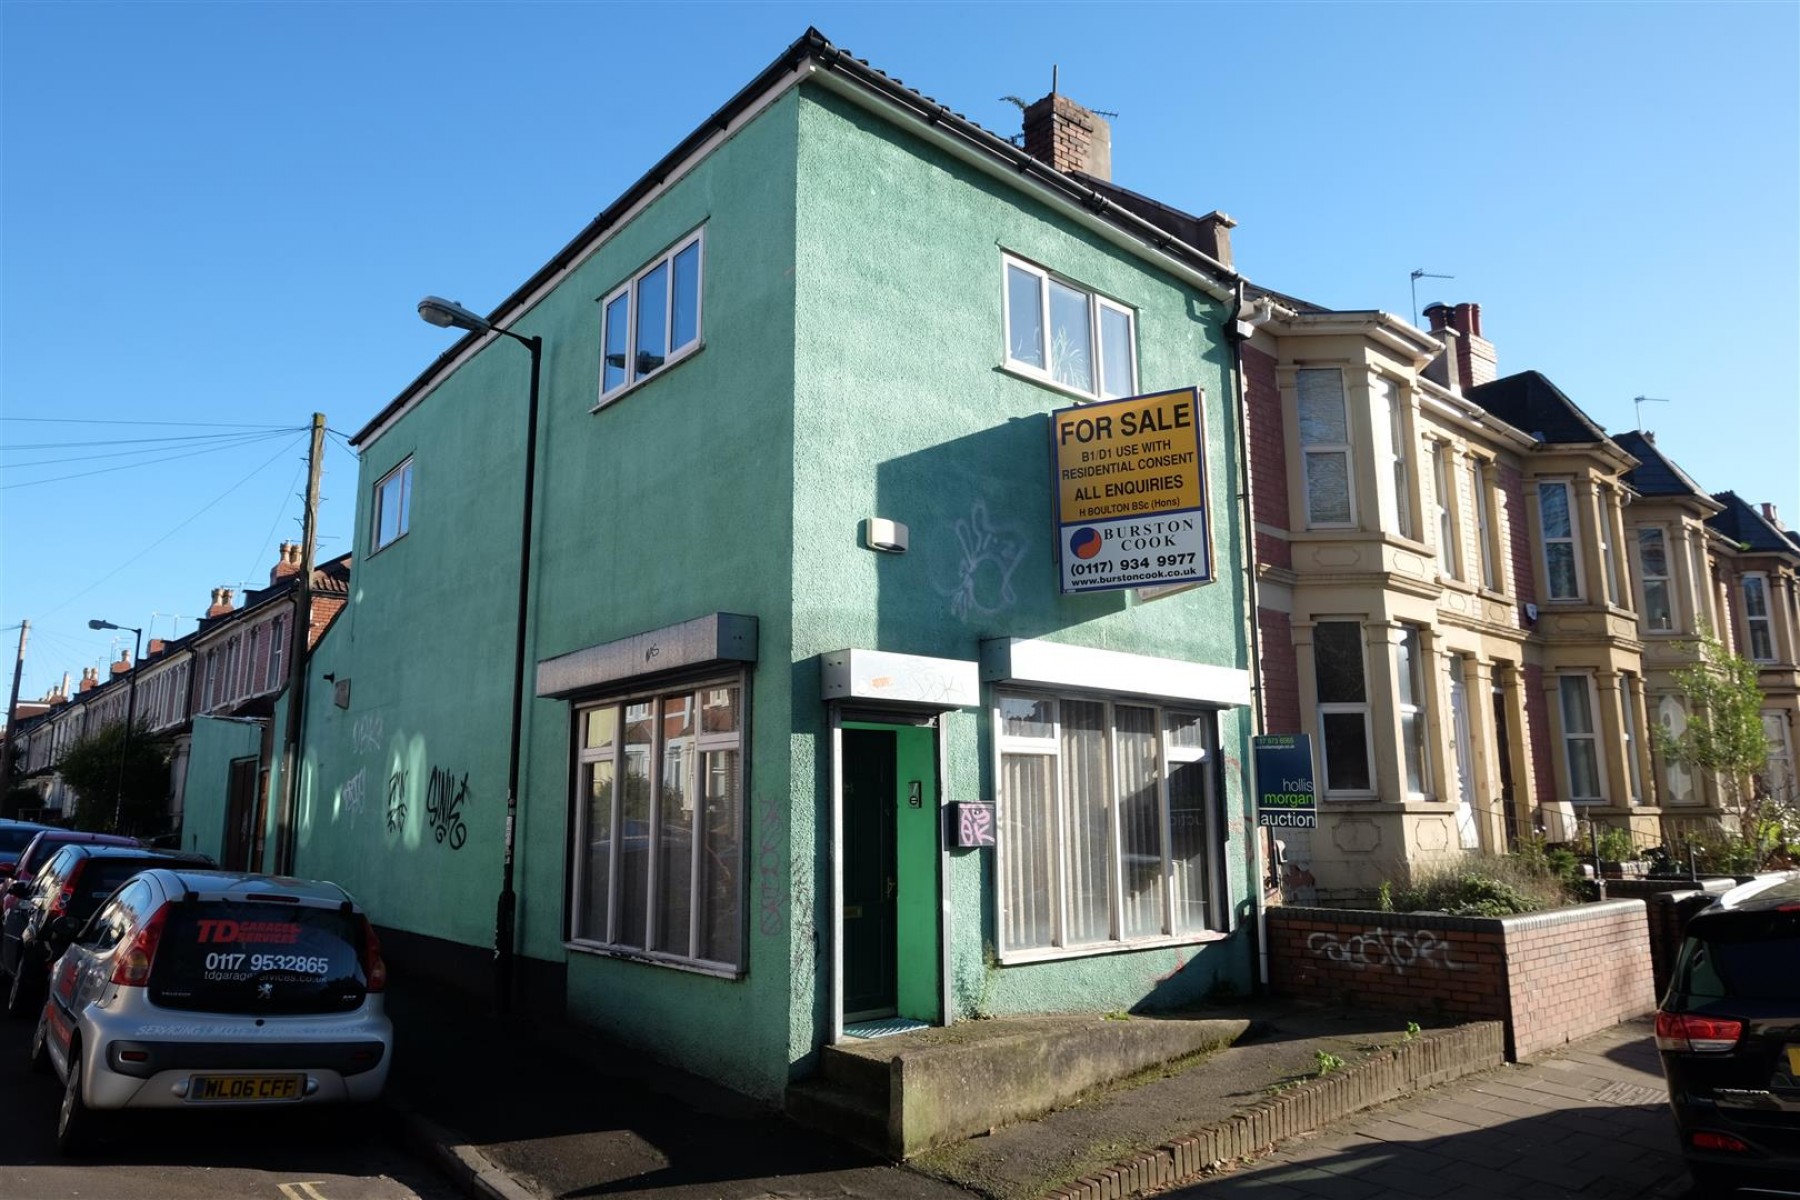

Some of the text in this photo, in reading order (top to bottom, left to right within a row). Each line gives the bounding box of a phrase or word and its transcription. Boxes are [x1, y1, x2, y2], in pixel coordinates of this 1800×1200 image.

[1060, 403, 1191, 446] FOR SALE
[1081, 439, 1171, 463] B1/D1 USE WITH
[1062, 452, 1194, 481] RESIDENTIAL CONSENT
[1075, 475, 1184, 502] ALL ENQUIRIES
[1079, 508, 1087, 517] H
[1087, 503, 1130, 517] BOULTON
[1151, 497, 1181, 511] (Hons)
[1103, 518, 1194, 541] BURSTON
[1121, 534, 1177, 552] COOK
[1070, 552, 1196, 577] (0117) 934 9977
[1071, 567, 1197, 587] www.burstoncook.co.uk
[1282, 778, 1314, 792] hollis
[1264, 793, 1314, 808] morgan
[1260, 812, 1315, 827] auction
[197, 919, 240, 944] TD
[205, 952, 329, 974] 0117 9532865
[205, 1079, 296, 1097] WL06 CFF
